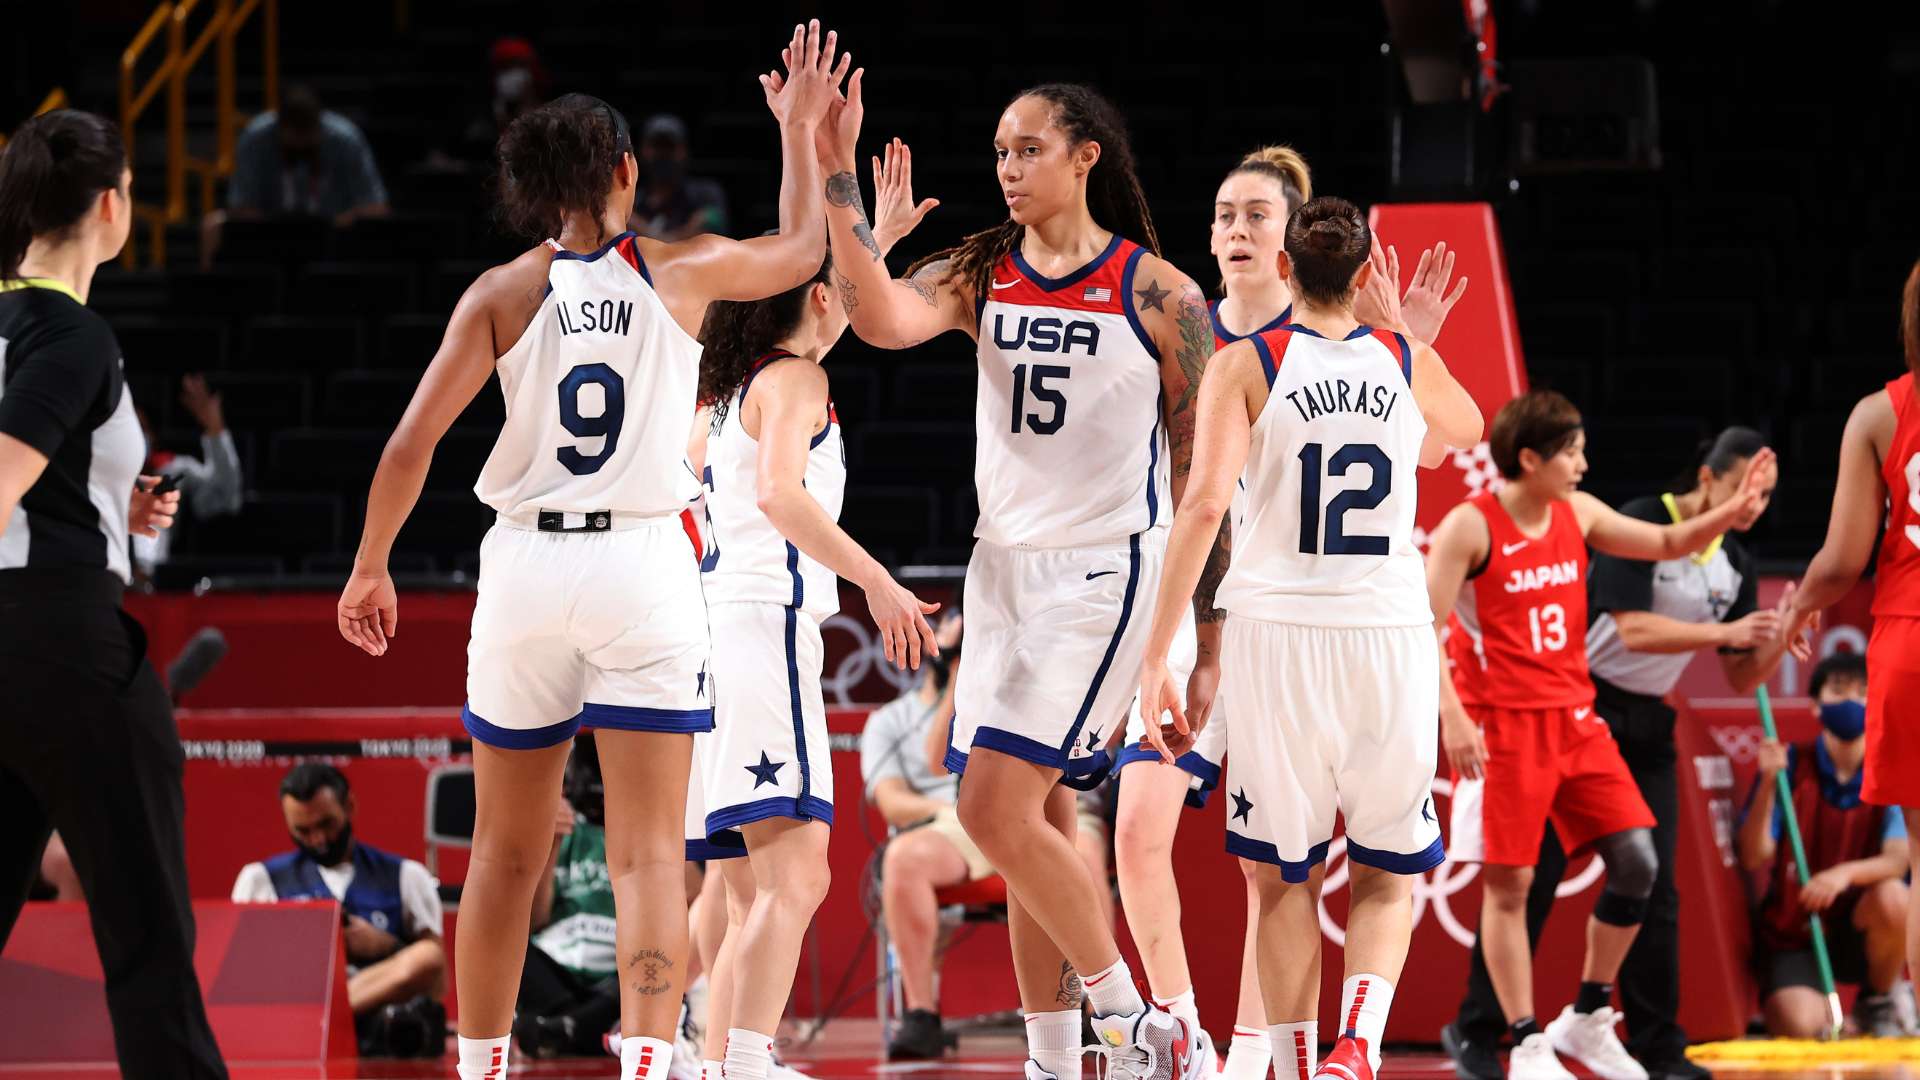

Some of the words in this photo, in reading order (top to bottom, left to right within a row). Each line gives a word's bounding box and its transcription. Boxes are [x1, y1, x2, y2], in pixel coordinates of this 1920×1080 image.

[994, 314, 1100, 356] USA
[556, 362, 625, 476] 9
[1011, 363, 1070, 435] 15
[1285, 379, 1397, 422] TAURASI
[1297, 442, 1392, 556] 12
[1504, 560, 1578, 593] JAPAN
[1528, 603, 1568, 654] 13
